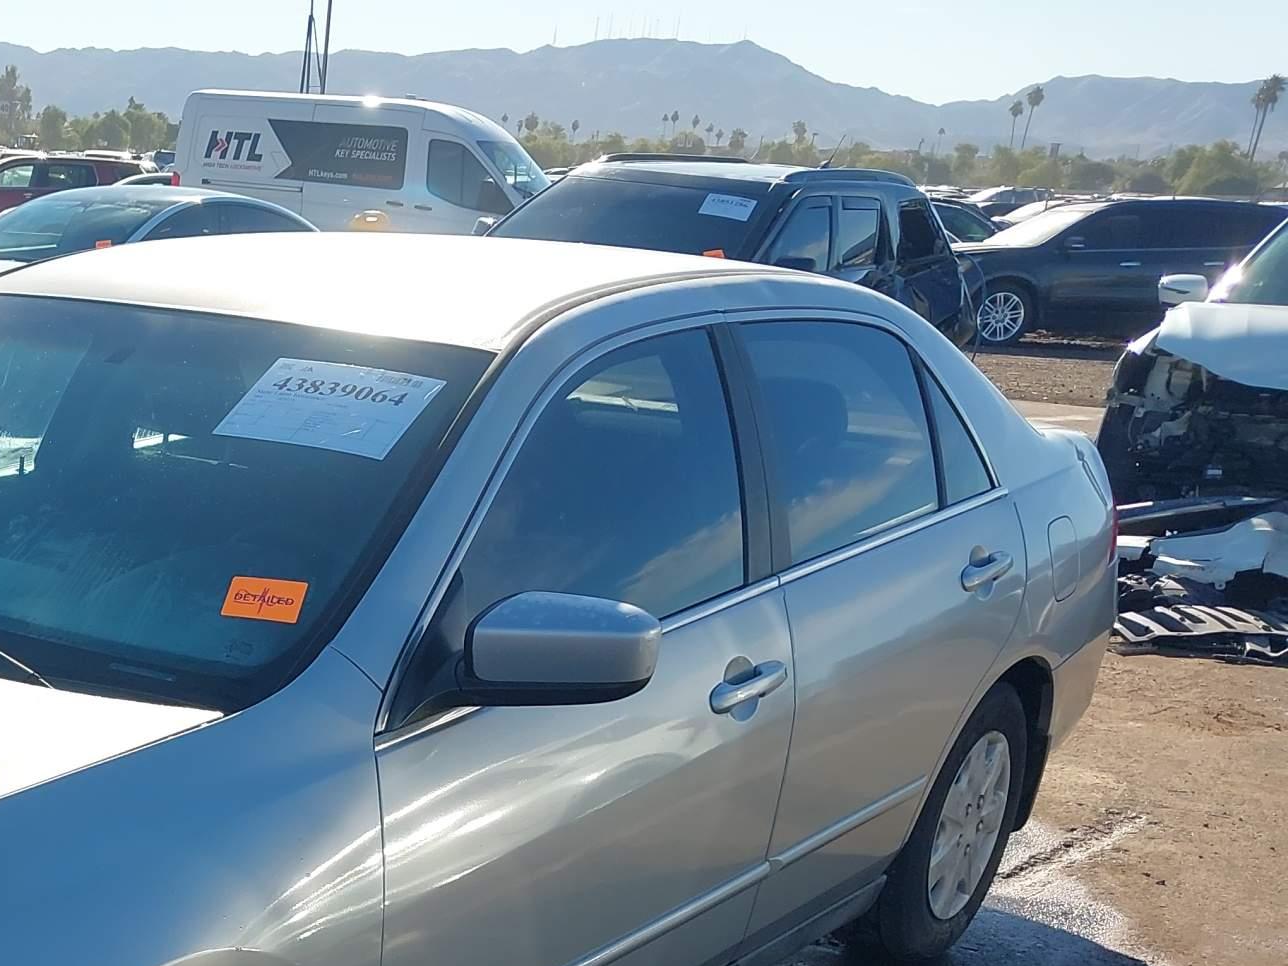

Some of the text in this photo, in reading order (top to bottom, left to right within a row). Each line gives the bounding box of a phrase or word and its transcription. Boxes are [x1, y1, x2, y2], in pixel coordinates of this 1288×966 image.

[204, 130, 263, 162] HTL
[339, 136, 399, 151] AUTOMOTIVE
[335, 148, 397, 162] KEY SPECIALISTS
[308, 168, 348, 179] HTLkeys.com
[272, 375, 409, 407] 43839064
